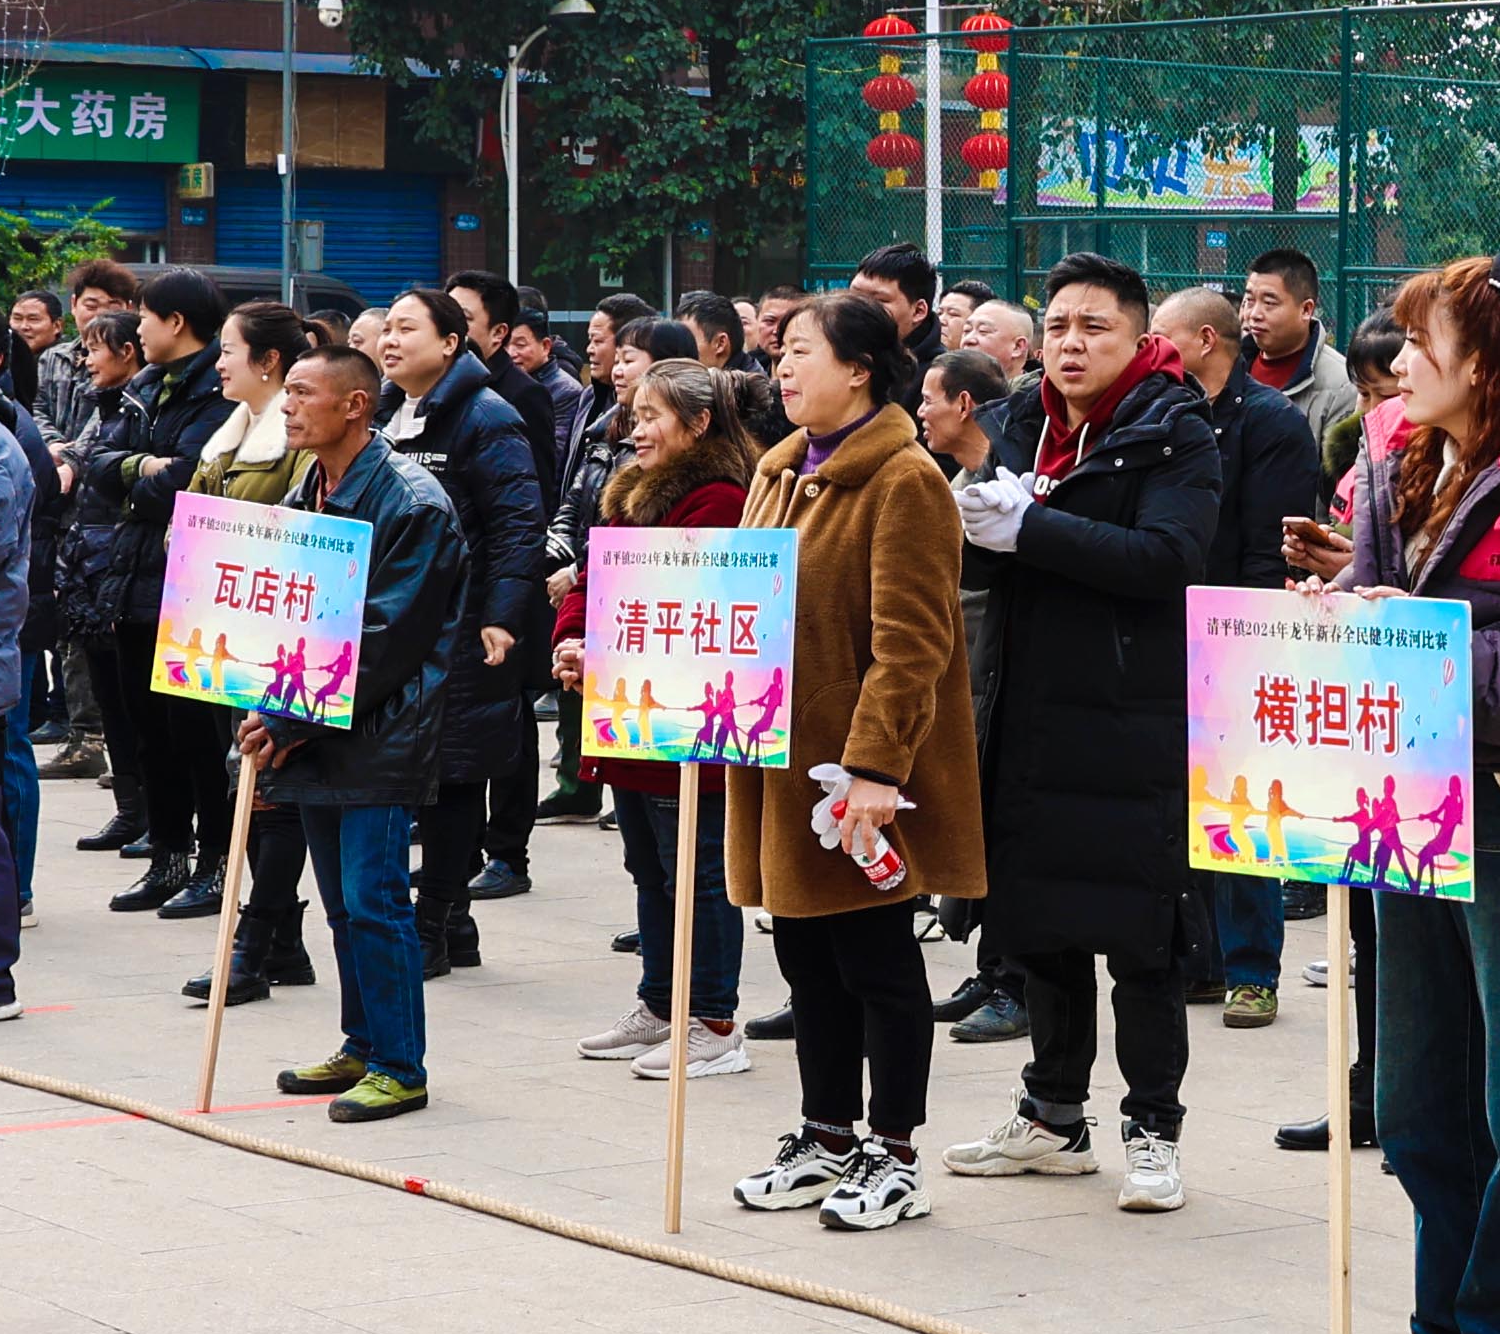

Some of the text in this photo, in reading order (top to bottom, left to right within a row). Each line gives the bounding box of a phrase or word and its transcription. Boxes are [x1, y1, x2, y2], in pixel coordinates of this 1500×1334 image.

[187, 513, 356, 556] 清平镇2024年龙年新春全民健身拔河比赛
[602, 549, 780, 569] 清平镇2024年龙年新春全民健身拔河比赛
[213, 561, 317, 624] 瓦店村
[614, 598, 761, 656] 清平社区
[1207, 616, 1449, 652] 清平镇2024年龙年新春全民健身拔河比赛
[1252, 673, 1402, 754] 横担村
